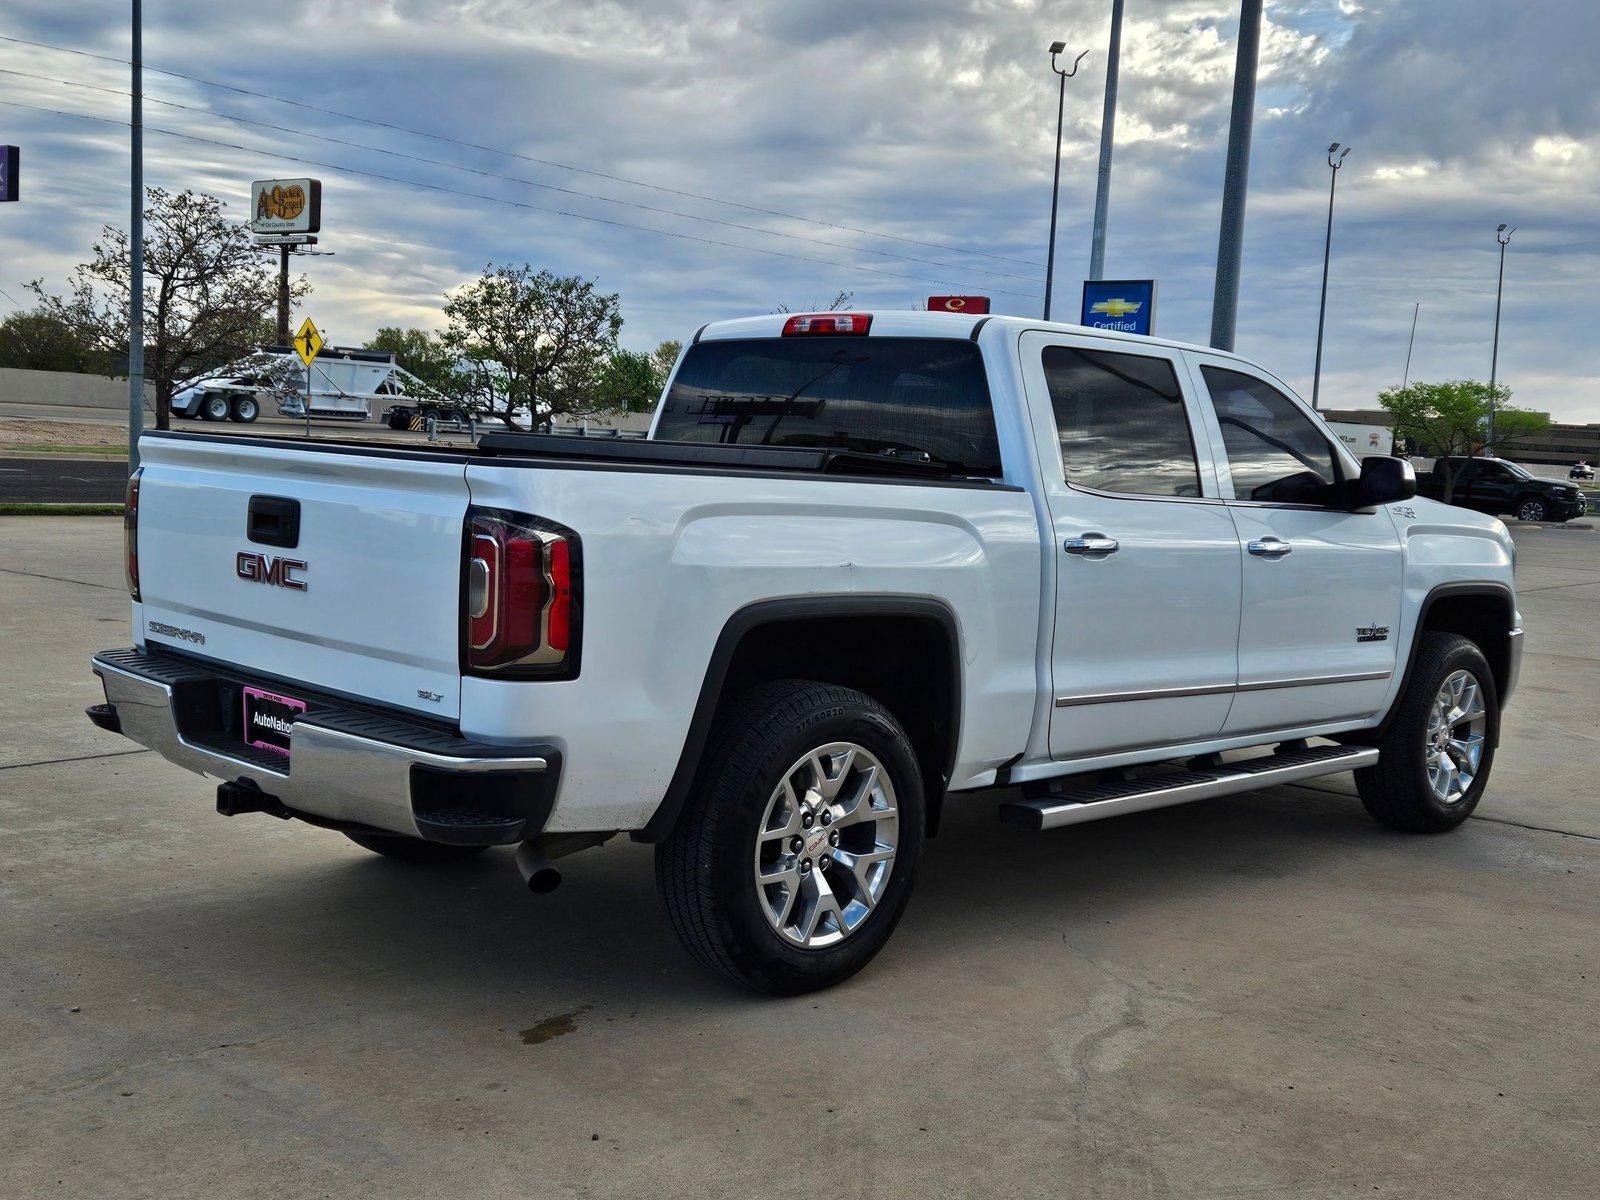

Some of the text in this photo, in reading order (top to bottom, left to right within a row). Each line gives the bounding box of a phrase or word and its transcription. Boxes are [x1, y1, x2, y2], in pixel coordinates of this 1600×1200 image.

[1093, 321, 1137, 331] Certified
[236, 551, 308, 592] GMC
[148, 620, 206, 645] SIERRA
[416, 689, 444, 702] SLT
[808, 832, 827, 852] GMC
